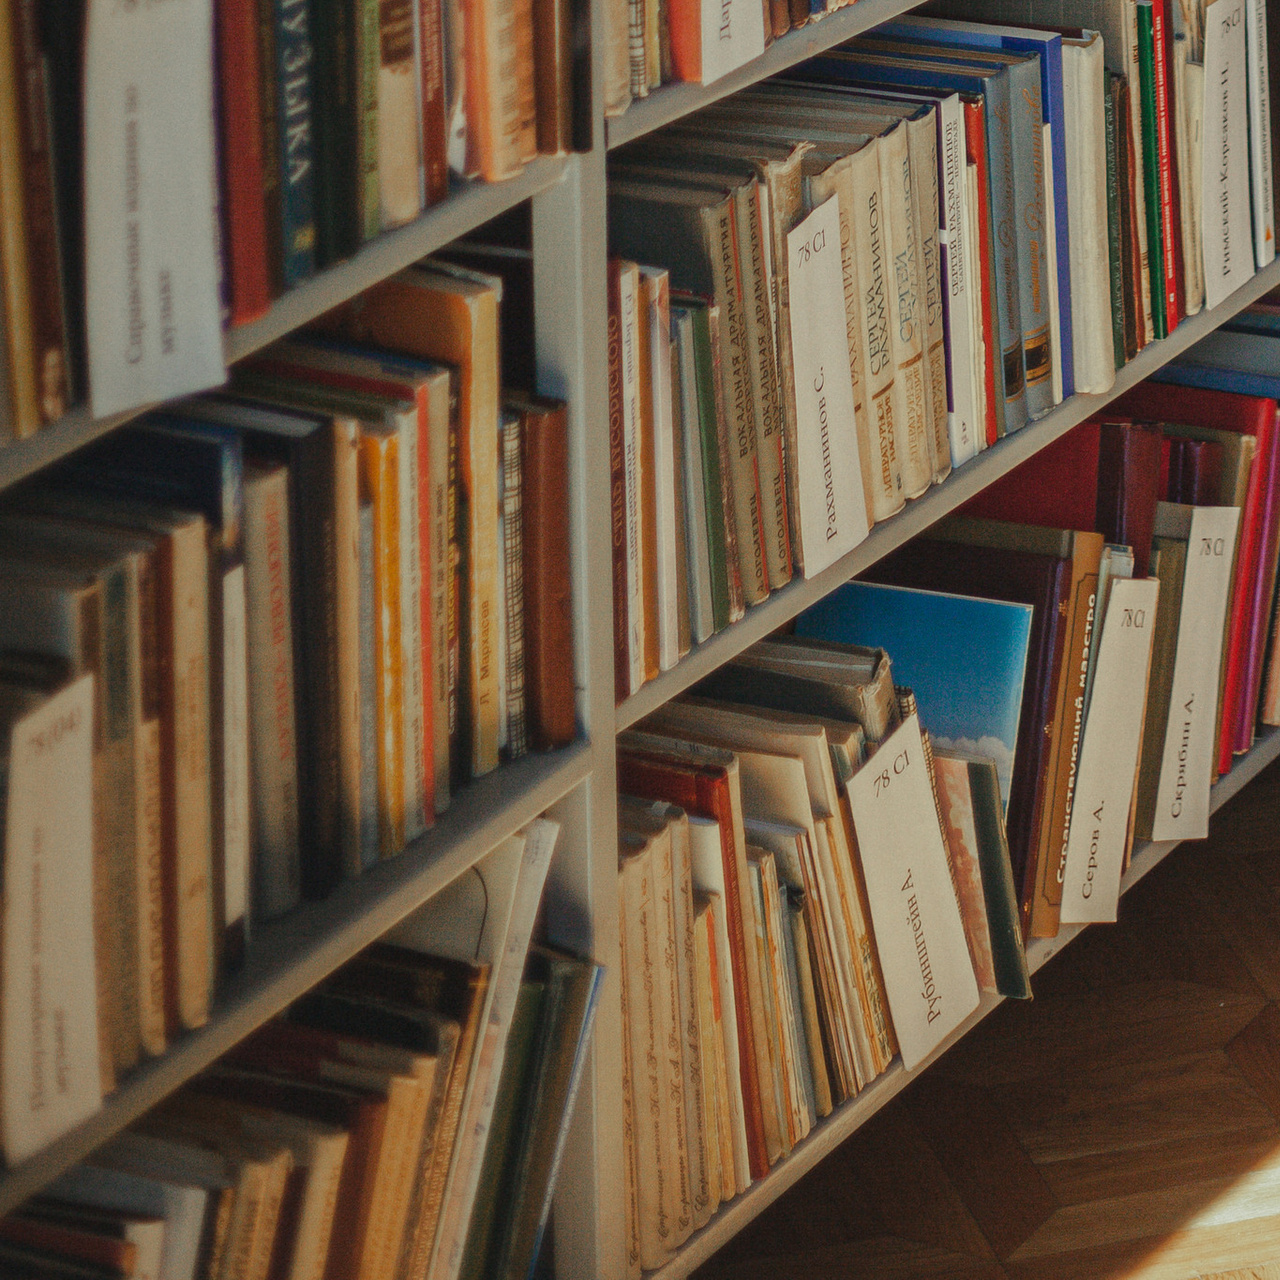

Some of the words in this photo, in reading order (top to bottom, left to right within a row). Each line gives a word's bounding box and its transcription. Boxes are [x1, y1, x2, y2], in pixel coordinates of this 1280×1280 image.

[1219, 61, 1229, 85] Н.
[945, 121, 957, 233] РАХМАНИНОВ
[1219, 89, 1233, 278] Римский-Корсаков
[719, 216, 742, 347] ДРАМАТУРГИЯ
[747, 195, 767, 328] ДРАМАТУРГИЯ
[797, 245, 811, 269] 78
[868, 190, 890, 370] РАХМАНИНОВ
[895, 251, 914, 342] СЕРГЕЙ
[949, 238, 960, 298] СЕРГЕЙ
[865, 287, 882, 376] СЕРГЕЙ
[730, 356, 749, 459] ВОКАЛЬНАЯ
[756, 334, 774, 439] ВОКАЛЬНАЯ
[812, 365, 825, 394] С.
[814, 395, 838, 541] Рахманинов
[749, 493, 764, 578] ОГОЛЕВЕЦ
[772, 472, 787, 560] ОГОЛЕВЕЦ
[1199, 537, 1213, 556] 78
[479, 599, 491, 681] Мархасев
[1121, 608, 1134, 628] 78
[872, 769, 891, 798] 78
[892, 749, 910, 776] С1
[1055, 695, 1085, 885] Странствующий
[1078, 593, 1096, 689] маэстро
[1170, 720, 1192, 819] Скрябин
[1183, 692, 1195, 715] А.
[900, 867, 915, 893] А.
[1081, 828, 1101, 900] Серов
[1091, 799, 1105, 822] А.
[905, 893, 941, 1027] Рубинштейн
